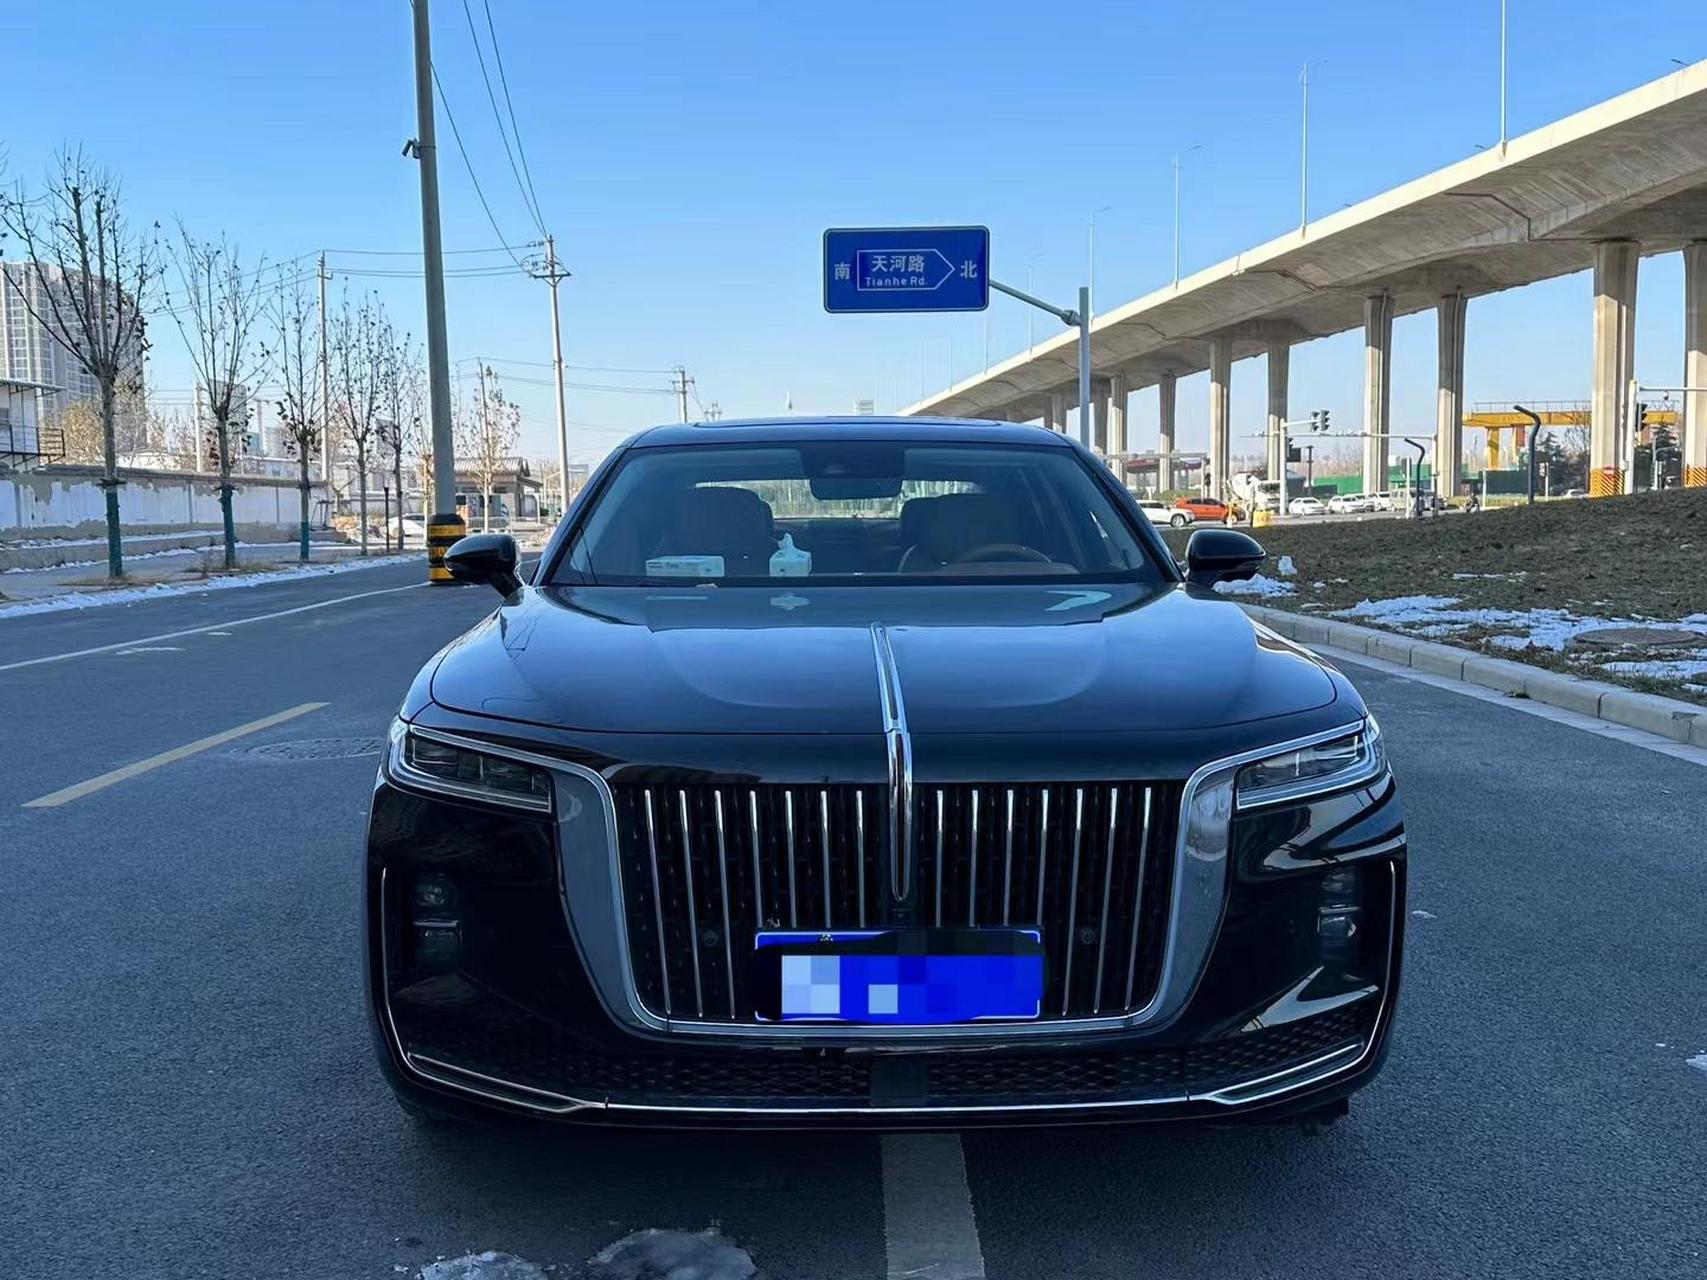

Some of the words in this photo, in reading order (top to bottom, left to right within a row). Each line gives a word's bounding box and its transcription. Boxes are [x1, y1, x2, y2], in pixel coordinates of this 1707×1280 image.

[834, 262, 851, 280] 南
[872, 255, 925, 273] 天河路
[960, 260, 978, 278] 北
[865, 276, 907, 286] Tianhe
